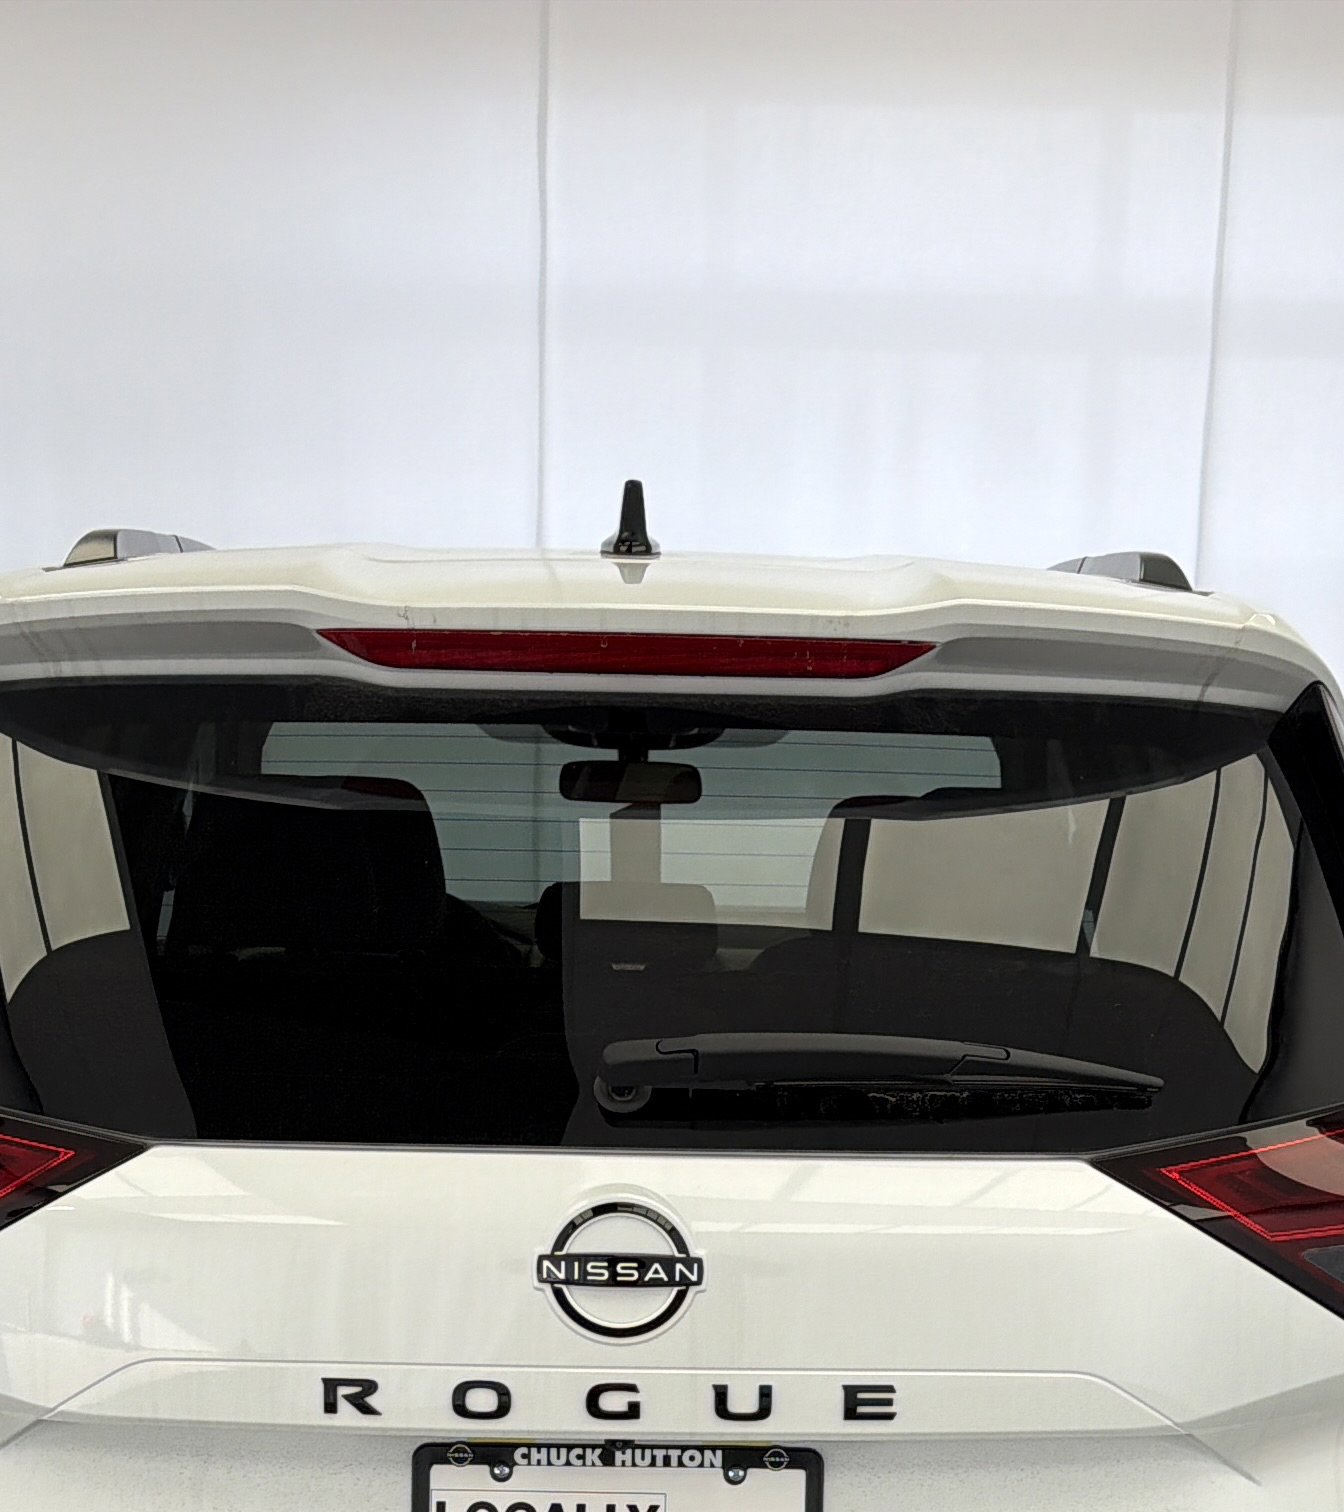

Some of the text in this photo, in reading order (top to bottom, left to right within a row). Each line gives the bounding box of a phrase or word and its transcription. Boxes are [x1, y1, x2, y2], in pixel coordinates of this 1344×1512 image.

[542, 1259, 698, 1283] NISSAN
[321, 1377, 898, 1421] ROGUE
[513, 1447, 723, 1468] CHUCK HUTTON
